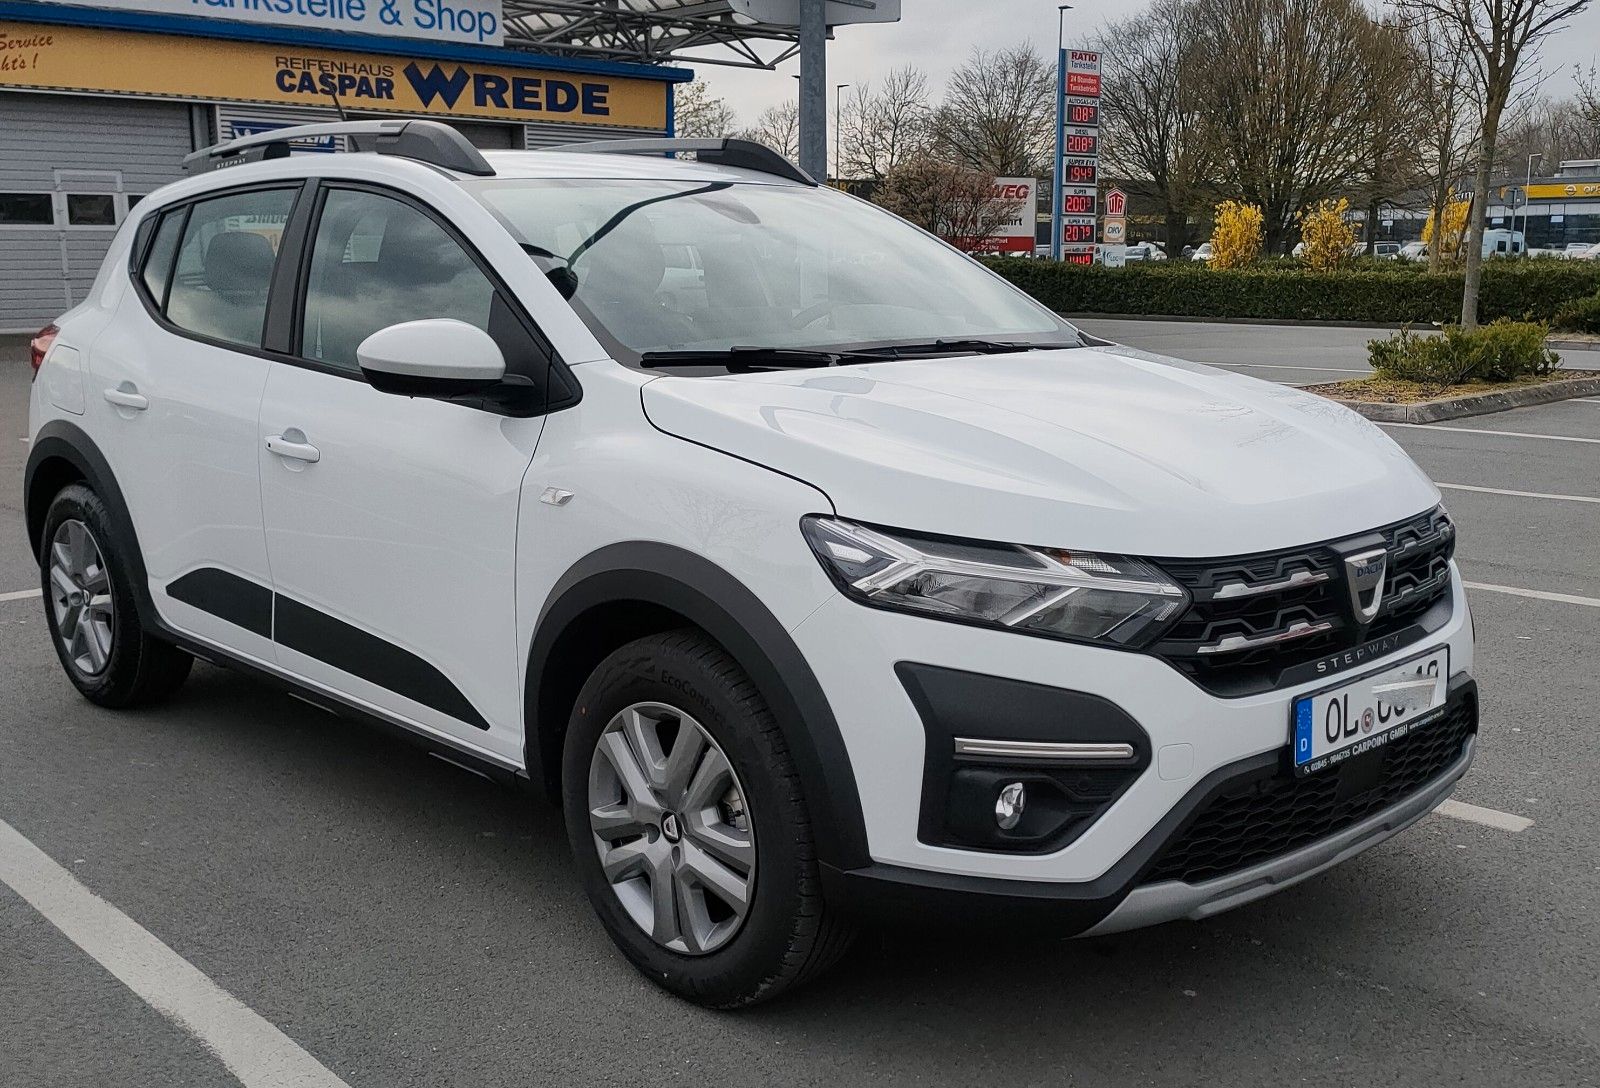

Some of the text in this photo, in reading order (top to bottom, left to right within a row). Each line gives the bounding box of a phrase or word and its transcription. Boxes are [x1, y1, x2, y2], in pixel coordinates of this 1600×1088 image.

[379, 0, 404, 26] &
[413, 0, 497, 41] Shop
[0, 33, 54, 50] Service
[1071, 51, 1097, 62] RATIO
[1071, 61, 1097, 70] Tankstelle
[275, 56, 395, 77] REIFENHAUS
[275, 61, 610, 116] CASPAR WREDE
[1068, 158, 1084, 166] SUPER
[1107, 226, 1122, 234] DKV
[1316, 635, 1400, 673] STEPWAY
[1325, 693, 1359, 744] OL
[1301, 738, 1308, 752] D
[1352, 732, 1389, 756] CARPOINT
